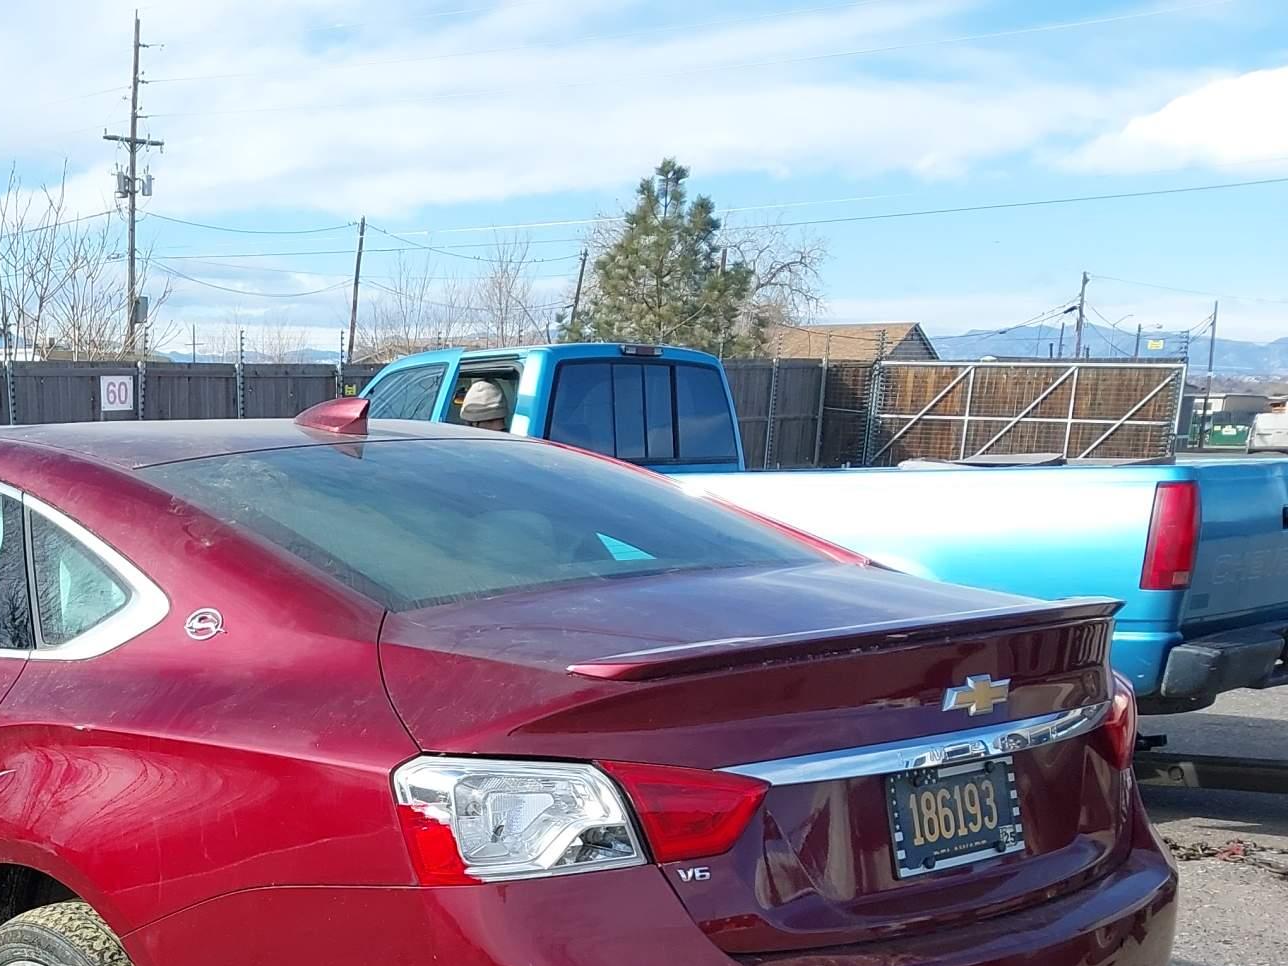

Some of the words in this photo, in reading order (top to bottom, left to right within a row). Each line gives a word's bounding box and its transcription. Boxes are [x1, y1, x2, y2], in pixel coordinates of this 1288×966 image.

[106, 381, 129, 405] 60
[909, 779, 998, 846] 186193
[677, 866, 712, 882] V6
